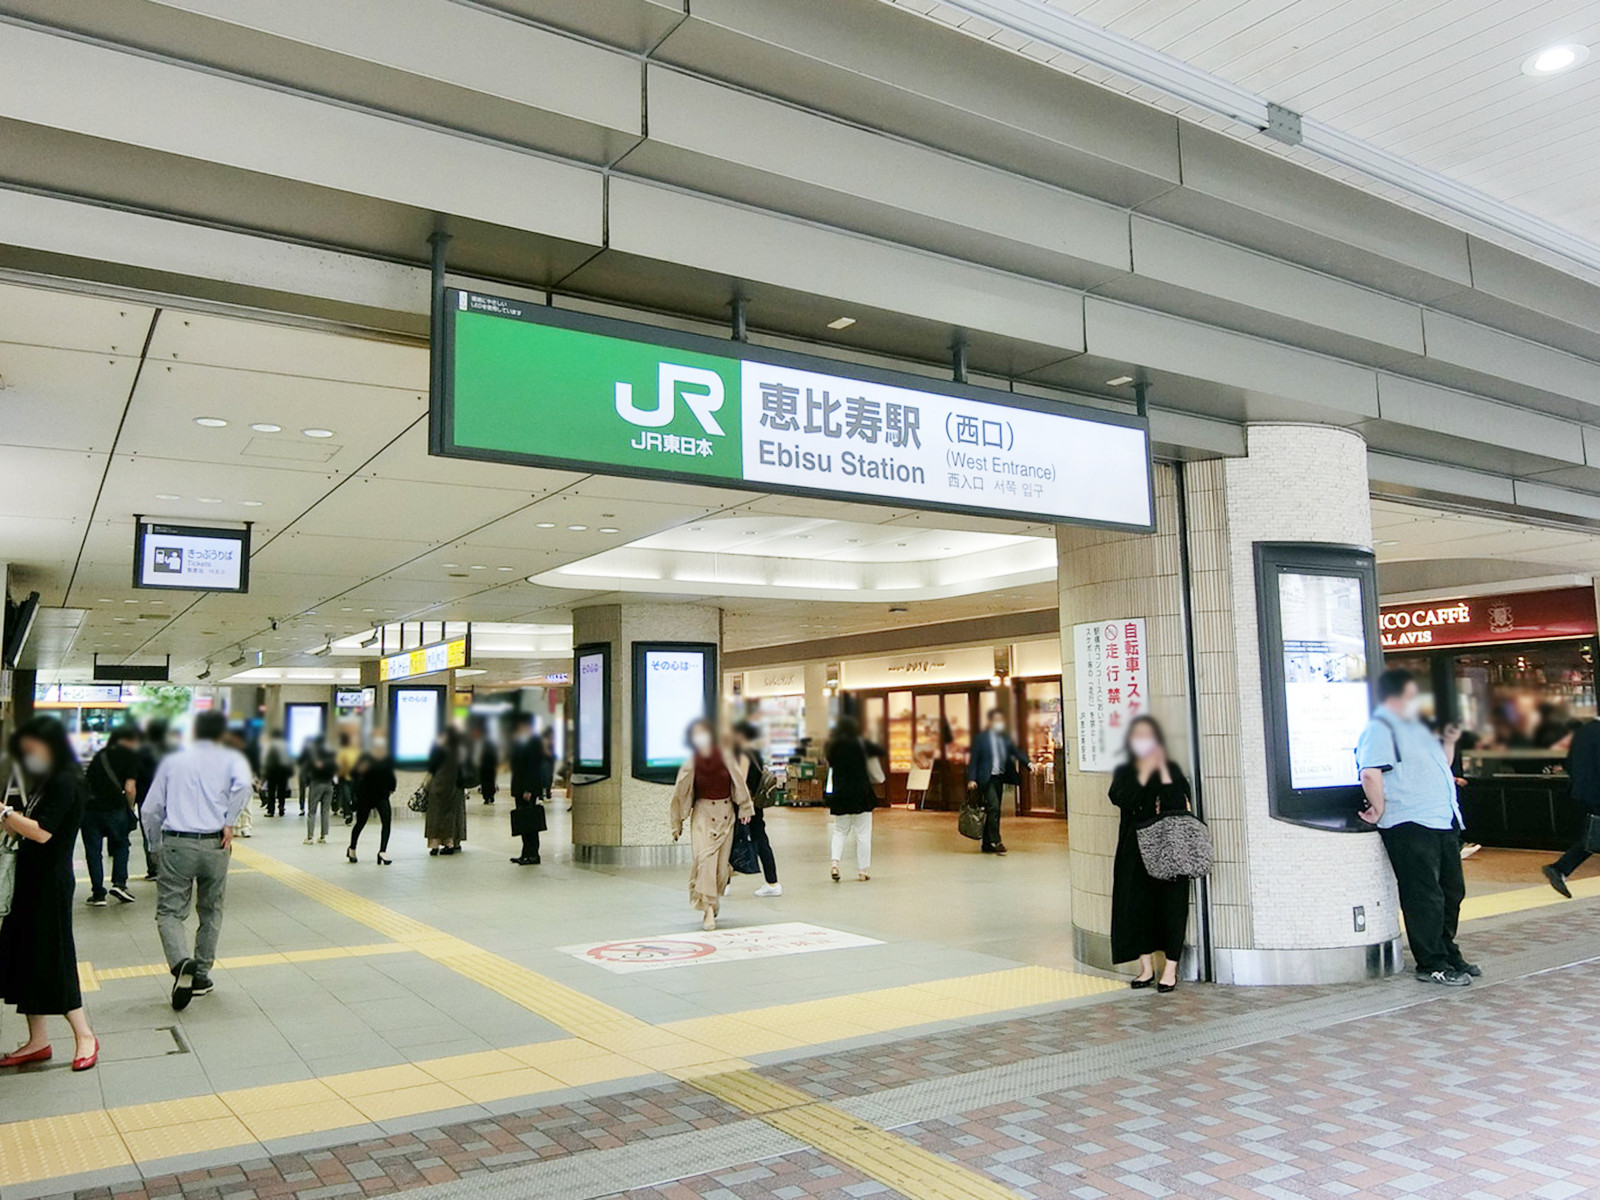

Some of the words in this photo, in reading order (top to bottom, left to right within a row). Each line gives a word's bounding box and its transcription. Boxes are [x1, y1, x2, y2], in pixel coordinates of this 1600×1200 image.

[615, 361, 726, 437] JR
[759, 381, 922, 450] 恵比寿駅
[631, 431, 713, 458] JR東日本
[759, 439, 832, 473] Ebisu
[841, 450, 925, 485] Station
[946, 449, 988, 473] (West
[992, 456, 1057, 482] Entrance)
[947, 472, 984, 491] 西入口
[993, 479, 1017, 498] 서쪽
[1022, 482, 1044, 499] 입구
[1379, 611, 1411, 630] ICO
[1412, 603, 1471, 627] CAFFÈ
[1398, 630, 1433, 645] AVIS
[1124, 622, 1142, 715] 自転車・スケ
